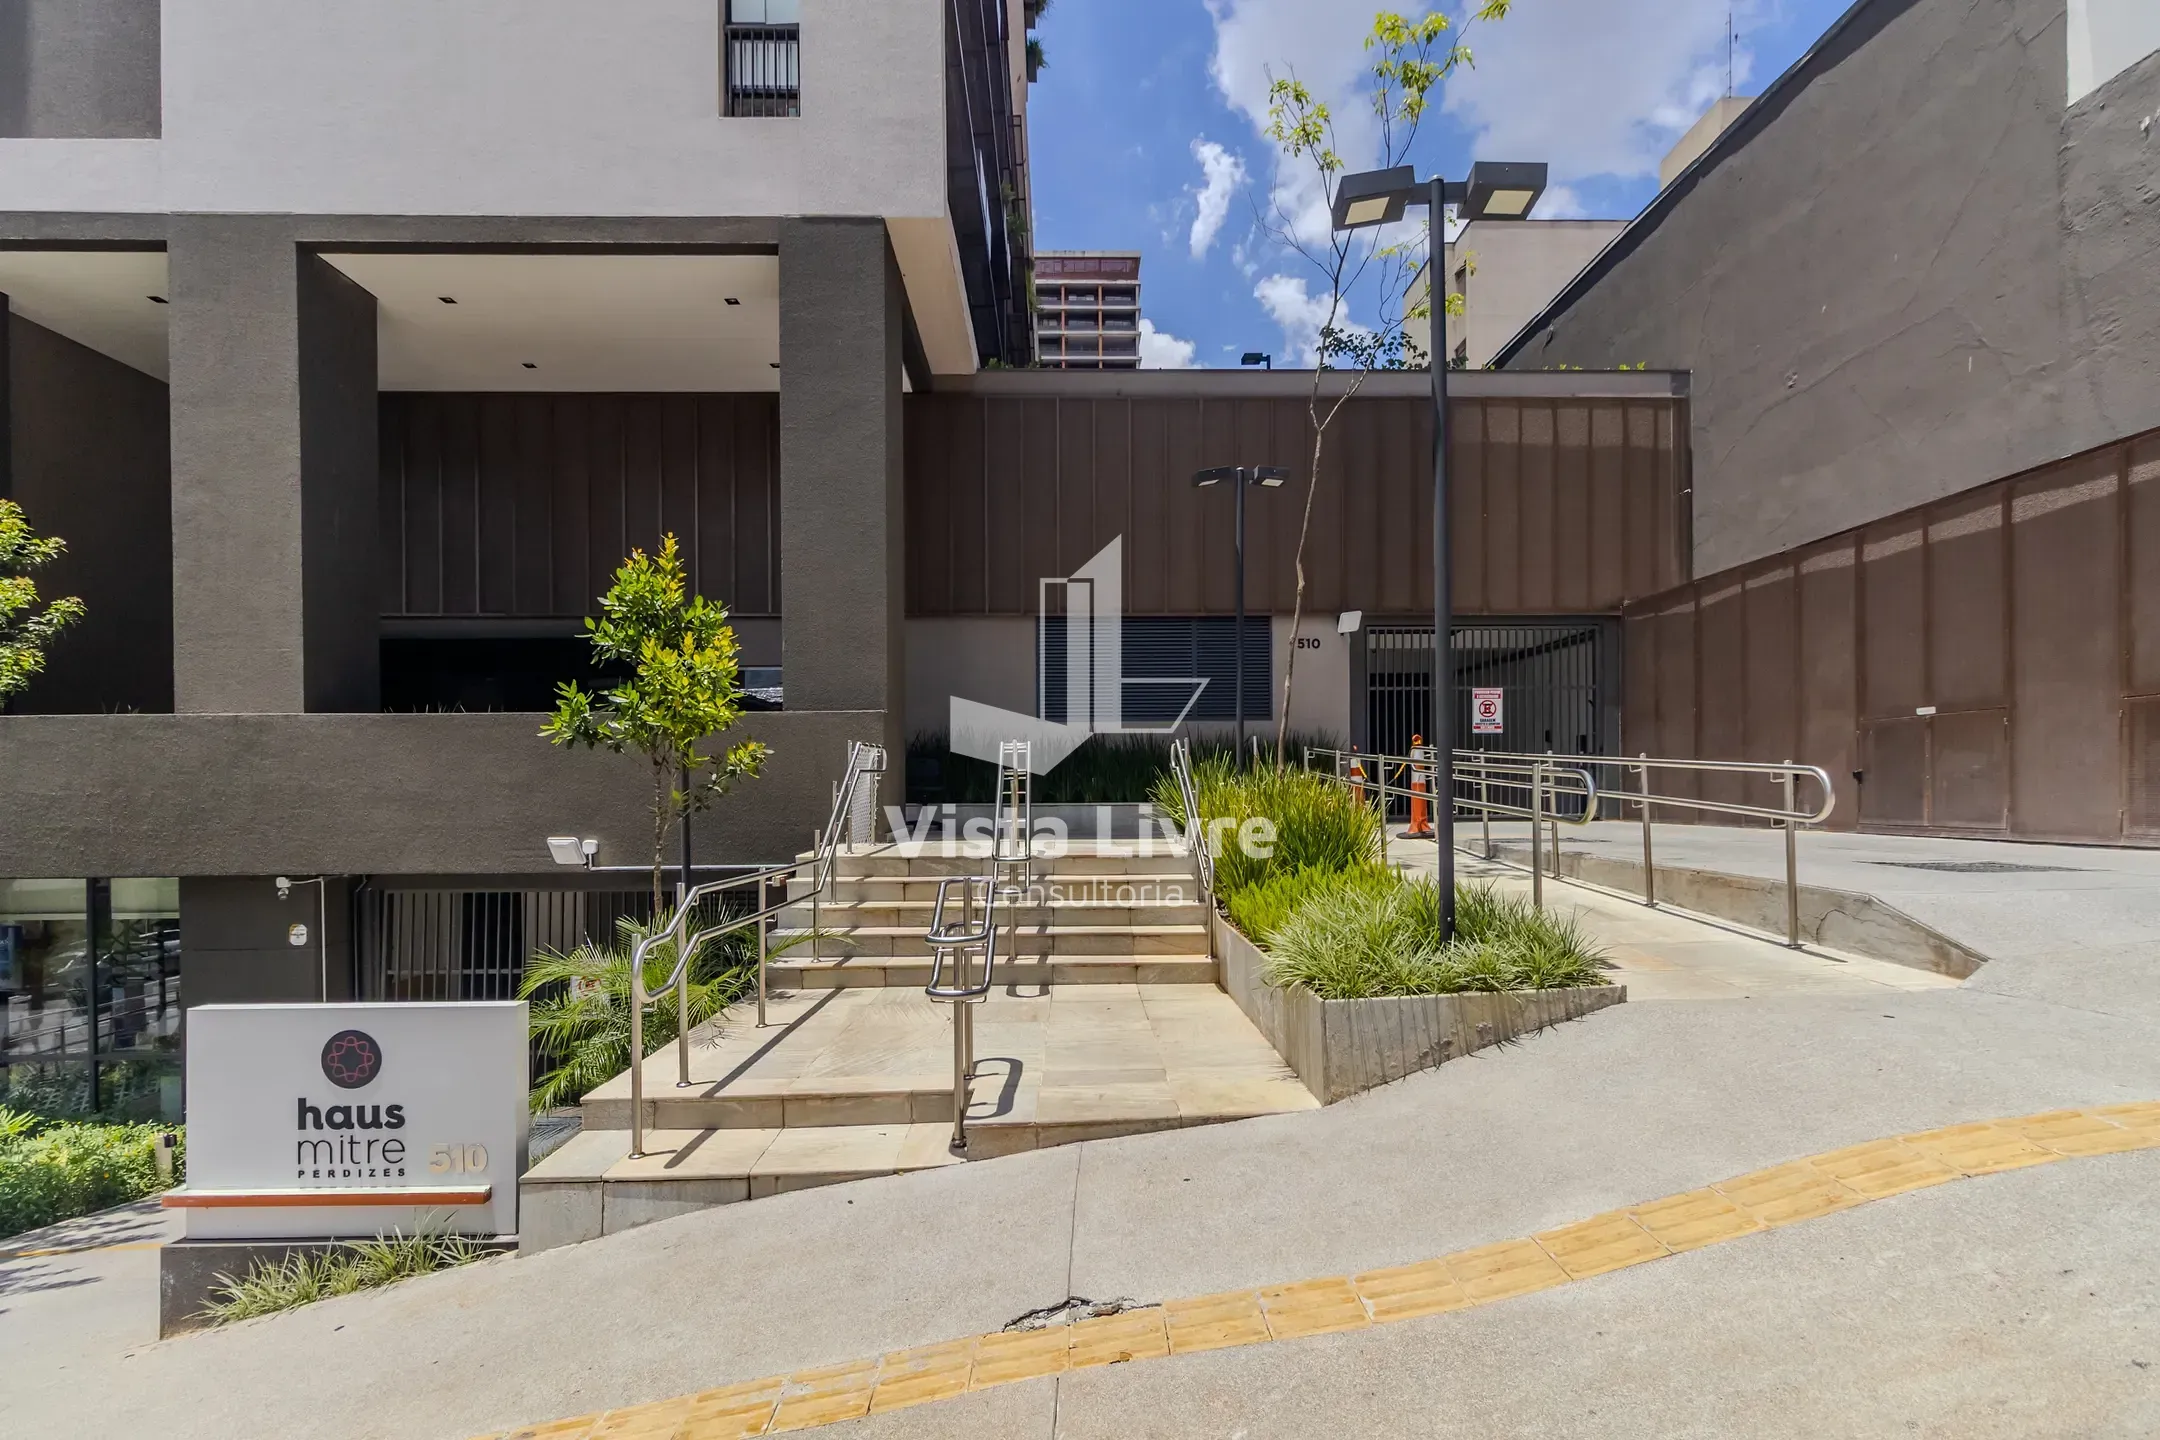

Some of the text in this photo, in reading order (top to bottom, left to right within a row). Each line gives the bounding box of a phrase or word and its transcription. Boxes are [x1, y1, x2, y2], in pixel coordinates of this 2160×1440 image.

[1297, 638, 1321, 649] 510
[297, 1097, 406, 1131] haus
[297, 1134, 406, 1165] mitre
[428, 1142, 489, 1175] 510
[297, 1167, 406, 1179] PERDIZES
